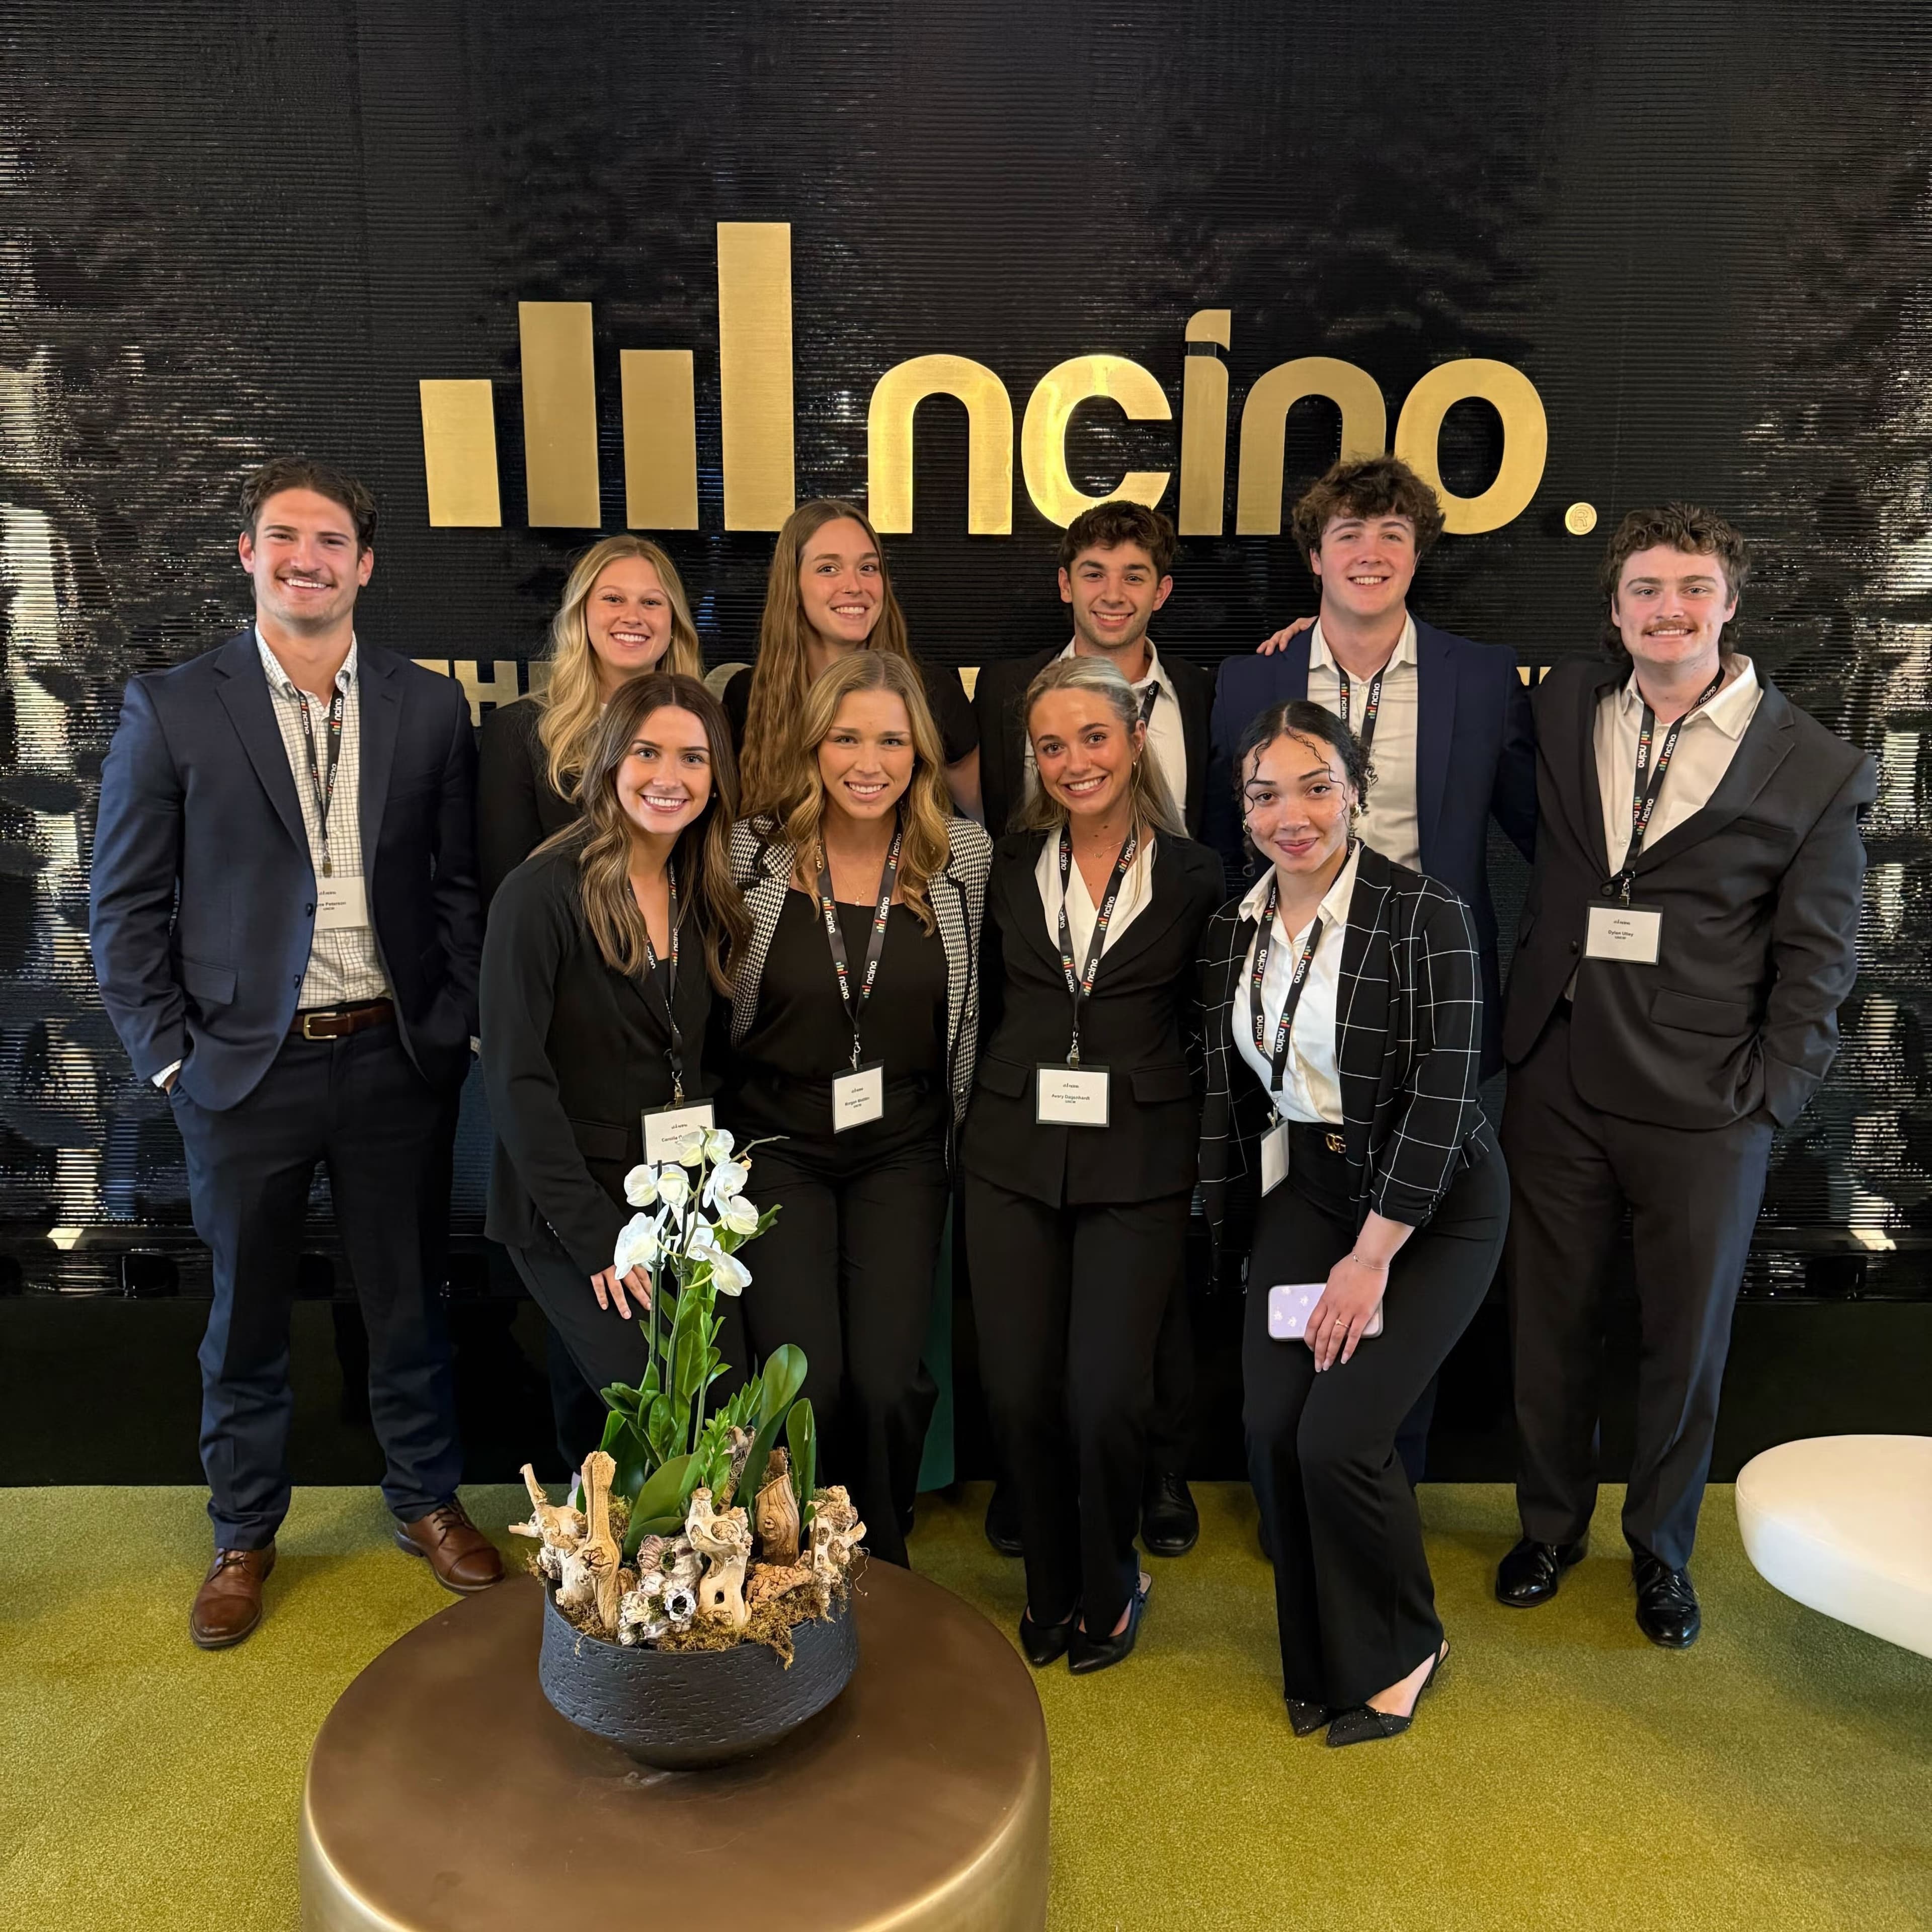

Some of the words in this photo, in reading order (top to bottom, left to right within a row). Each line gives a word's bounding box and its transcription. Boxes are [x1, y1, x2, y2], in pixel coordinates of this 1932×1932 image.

[1372, 683, 1380, 705] ncino
[1700, 686, 1716, 703] ncino
[333, 698, 342, 721] ncino
[1638, 745, 1647, 768] ncino
[1664, 734, 1676, 757] ncino
[1642, 798, 1654, 822] ncino
[893, 833, 902, 856] ncino
[1125, 840, 1137, 861] ncino
[880, 897, 890, 920] ncino
[1103, 896, 1115, 917] ncino
[825, 911, 835, 934] ncino
[867, 960, 877, 985] ncino
[1087, 958, 1098, 982] ncino
[1257, 949, 1267, 974] ncino
[1294, 959, 1307, 984] ncino
[839, 976, 850, 999] ncino
[1065, 970, 1074, 993] ncino
[1276, 1028, 1285, 1053] ncino
